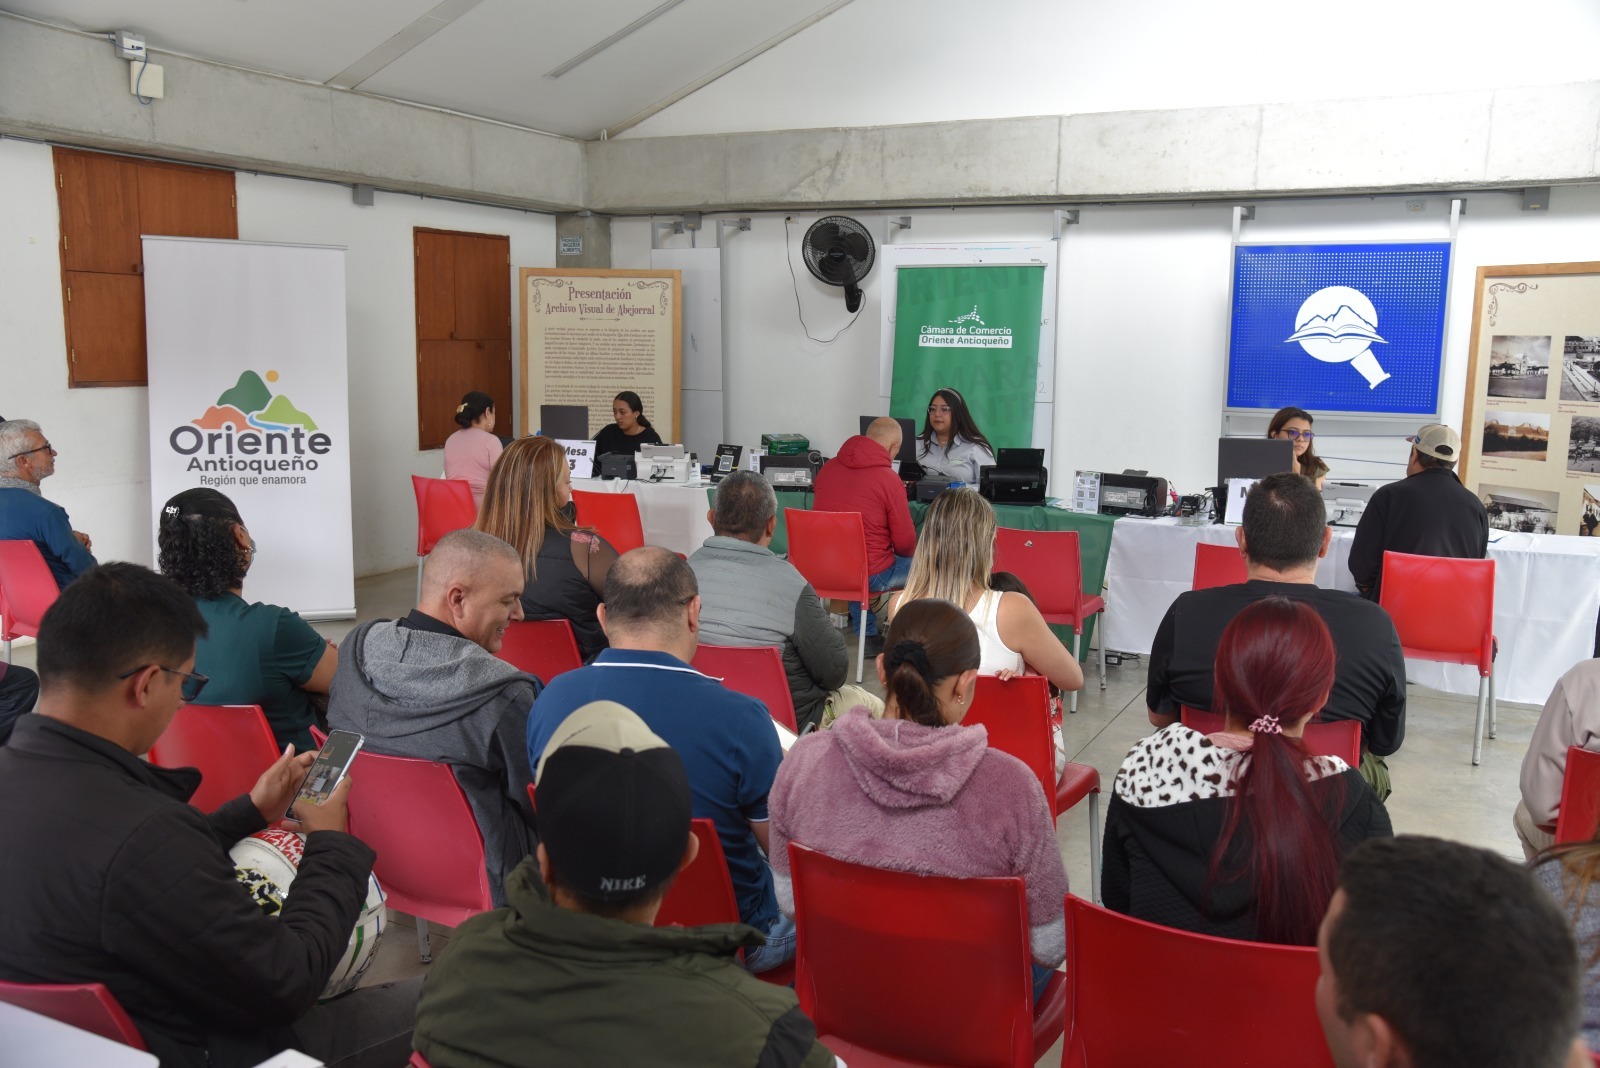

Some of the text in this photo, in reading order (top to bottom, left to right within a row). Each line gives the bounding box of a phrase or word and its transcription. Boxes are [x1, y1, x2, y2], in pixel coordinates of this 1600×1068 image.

[568, 286, 632, 301] Presentación
[545, 302, 655, 316] Archivo Visual de Abejorral
[921, 325, 1012, 335] Cámara de Comercio
[921, 335, 1009, 346] Oriente Antioqueño
[169, 424, 332, 456] Oriente
[186, 455, 319, 475] Antioqueño
[568, 458, 577, 471] 3
[200, 475, 306, 487] Región que enamora
[600, 874, 647, 891] NIKE
